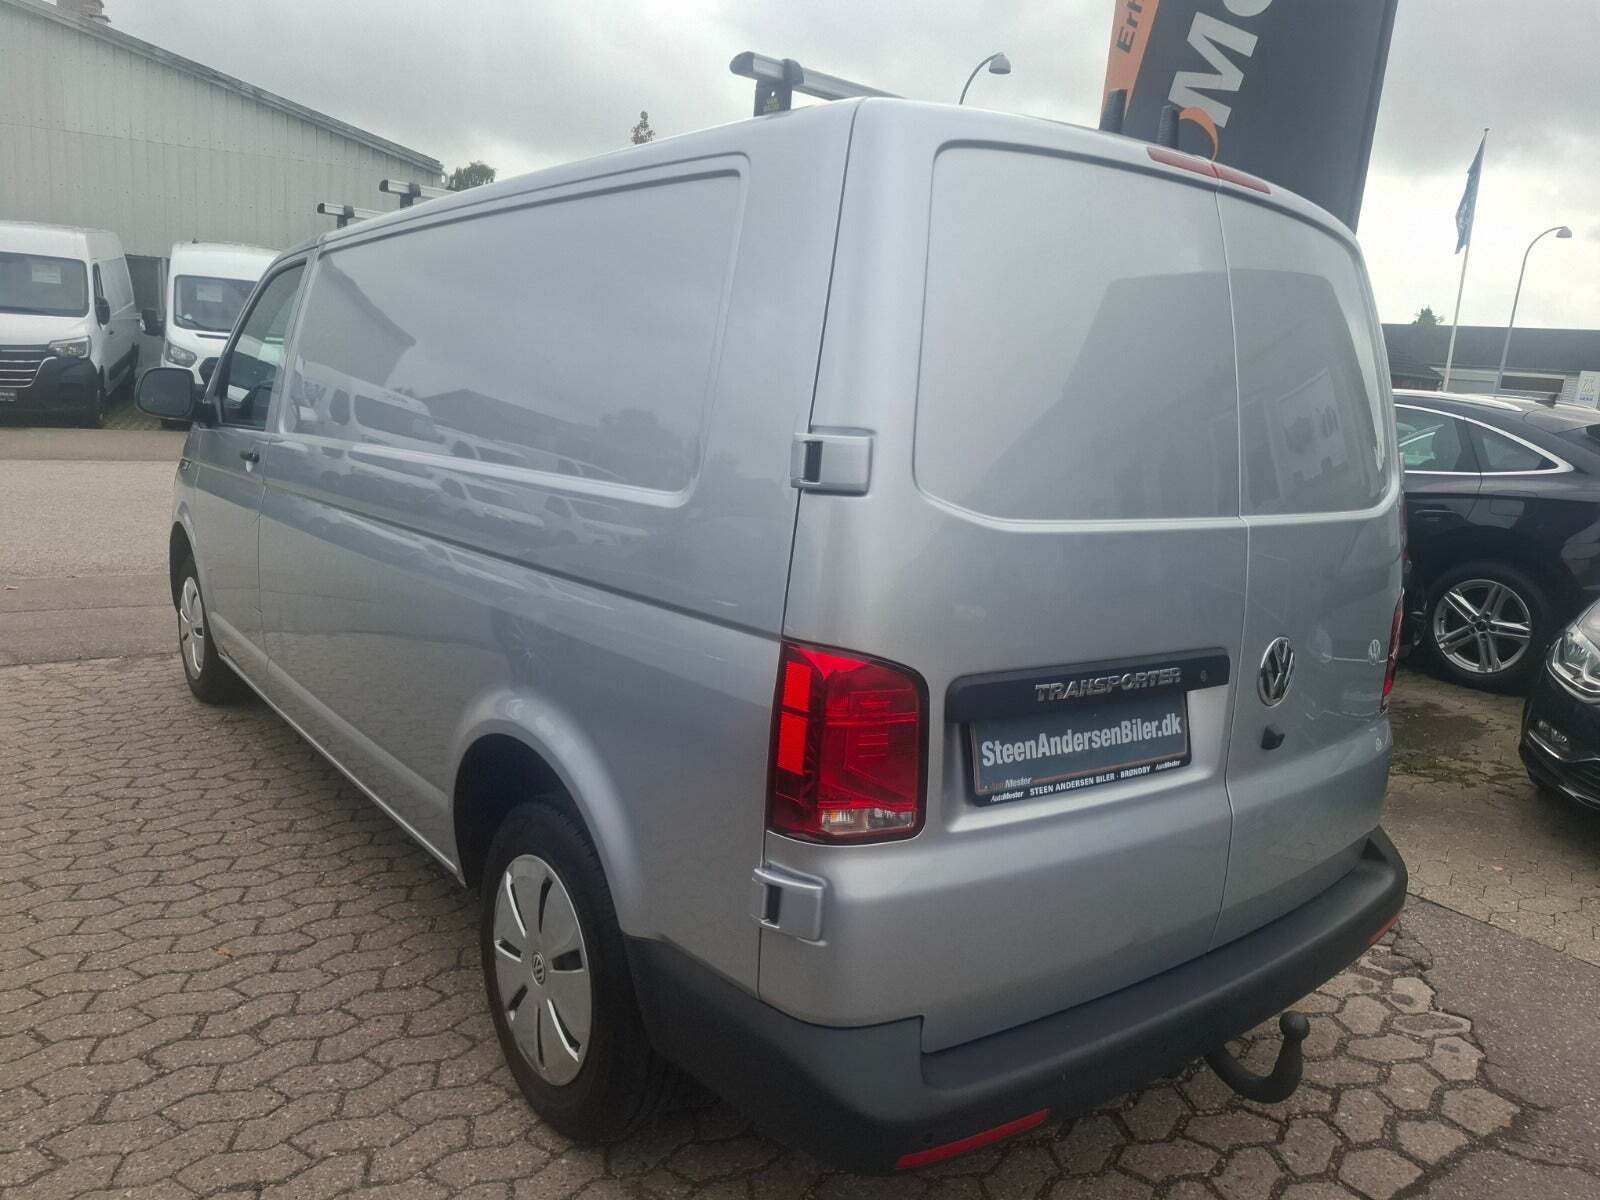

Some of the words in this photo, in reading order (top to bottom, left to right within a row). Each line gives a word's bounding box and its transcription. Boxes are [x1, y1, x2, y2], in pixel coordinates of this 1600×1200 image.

[1035, 667, 1182, 701] TRANSPORTER
[981, 713, 1182, 766] SteenAndersenBiler.dk
[1029, 785, 1054, 796] STEEN
[1055, 777, 1094, 791] ANDERSEN
[1096, 773, 1115, 784] BILER
